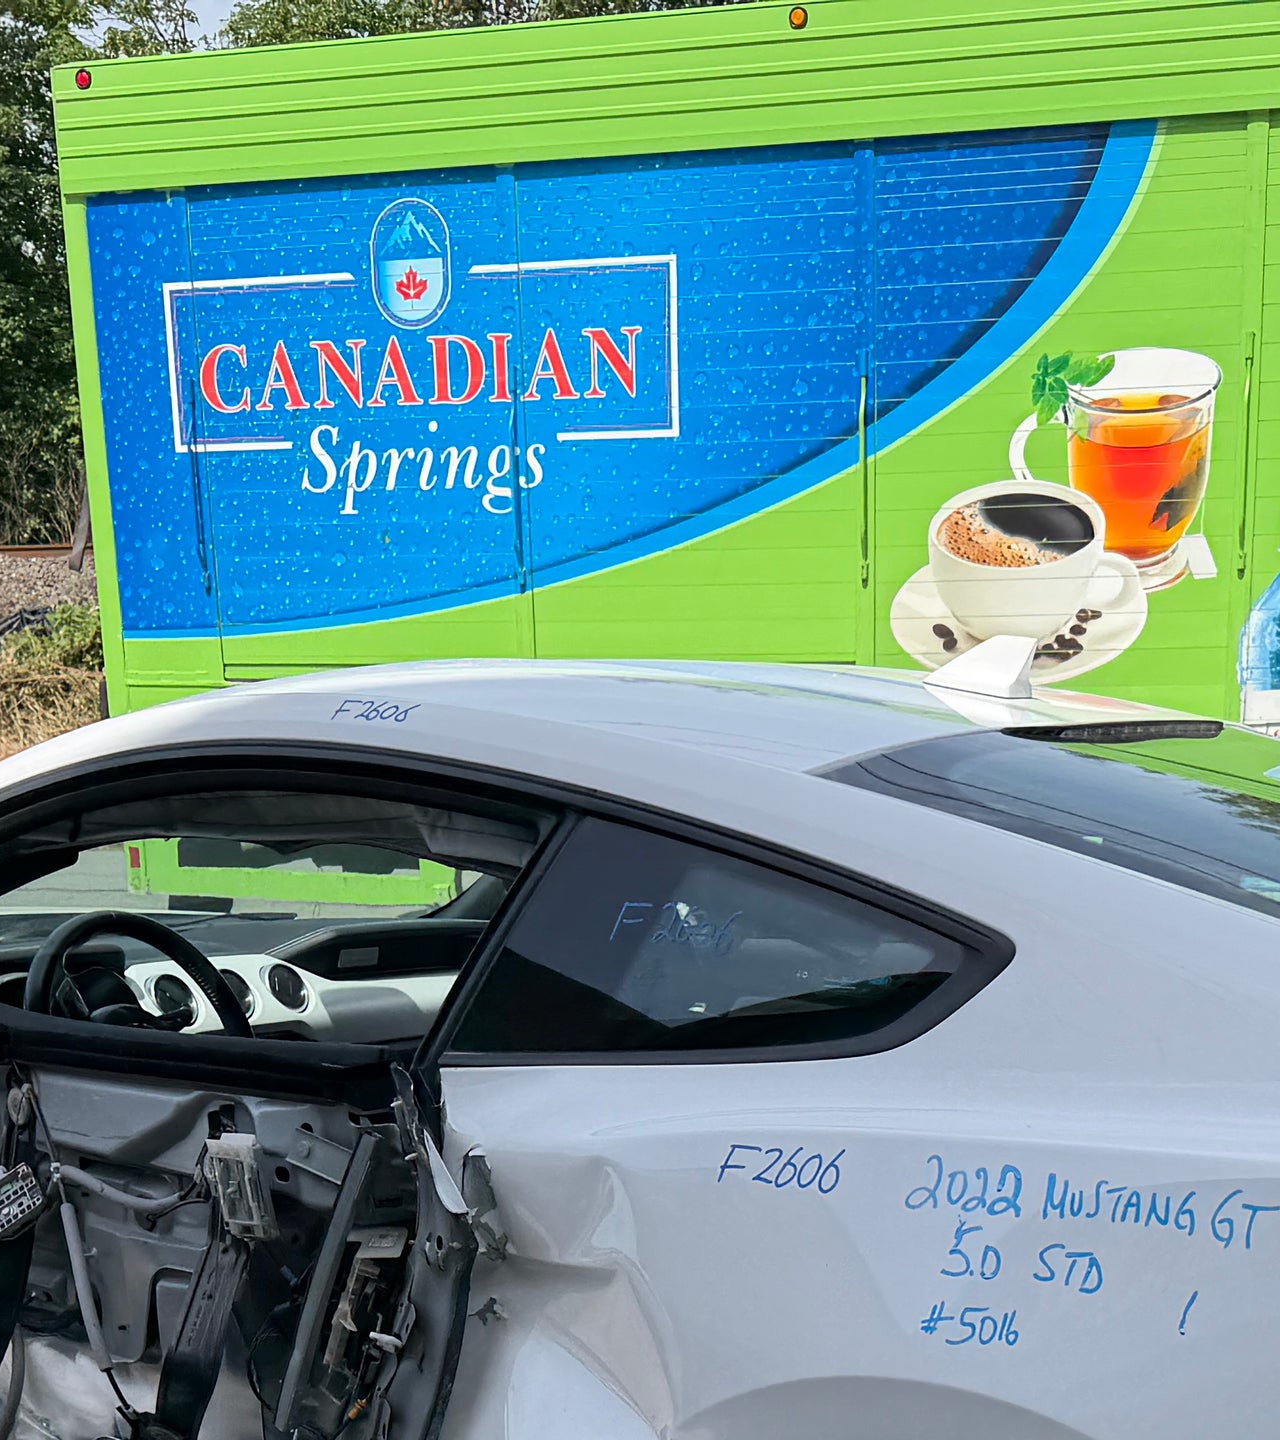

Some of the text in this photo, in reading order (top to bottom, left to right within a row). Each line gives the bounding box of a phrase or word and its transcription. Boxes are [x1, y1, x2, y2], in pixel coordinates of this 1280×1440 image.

[200, 326, 642, 413] CANADIAN
[300, 420, 547, 515] Springs
[331, 699, 422, 723] F2606
[718, 1143, 847, 1194] F2606
[904, 1155, 1280, 1249] 2022 MUSTANG GT
[1033, 1243, 1104, 1294] STD
[921, 1301, 1020, 1346] #5016
